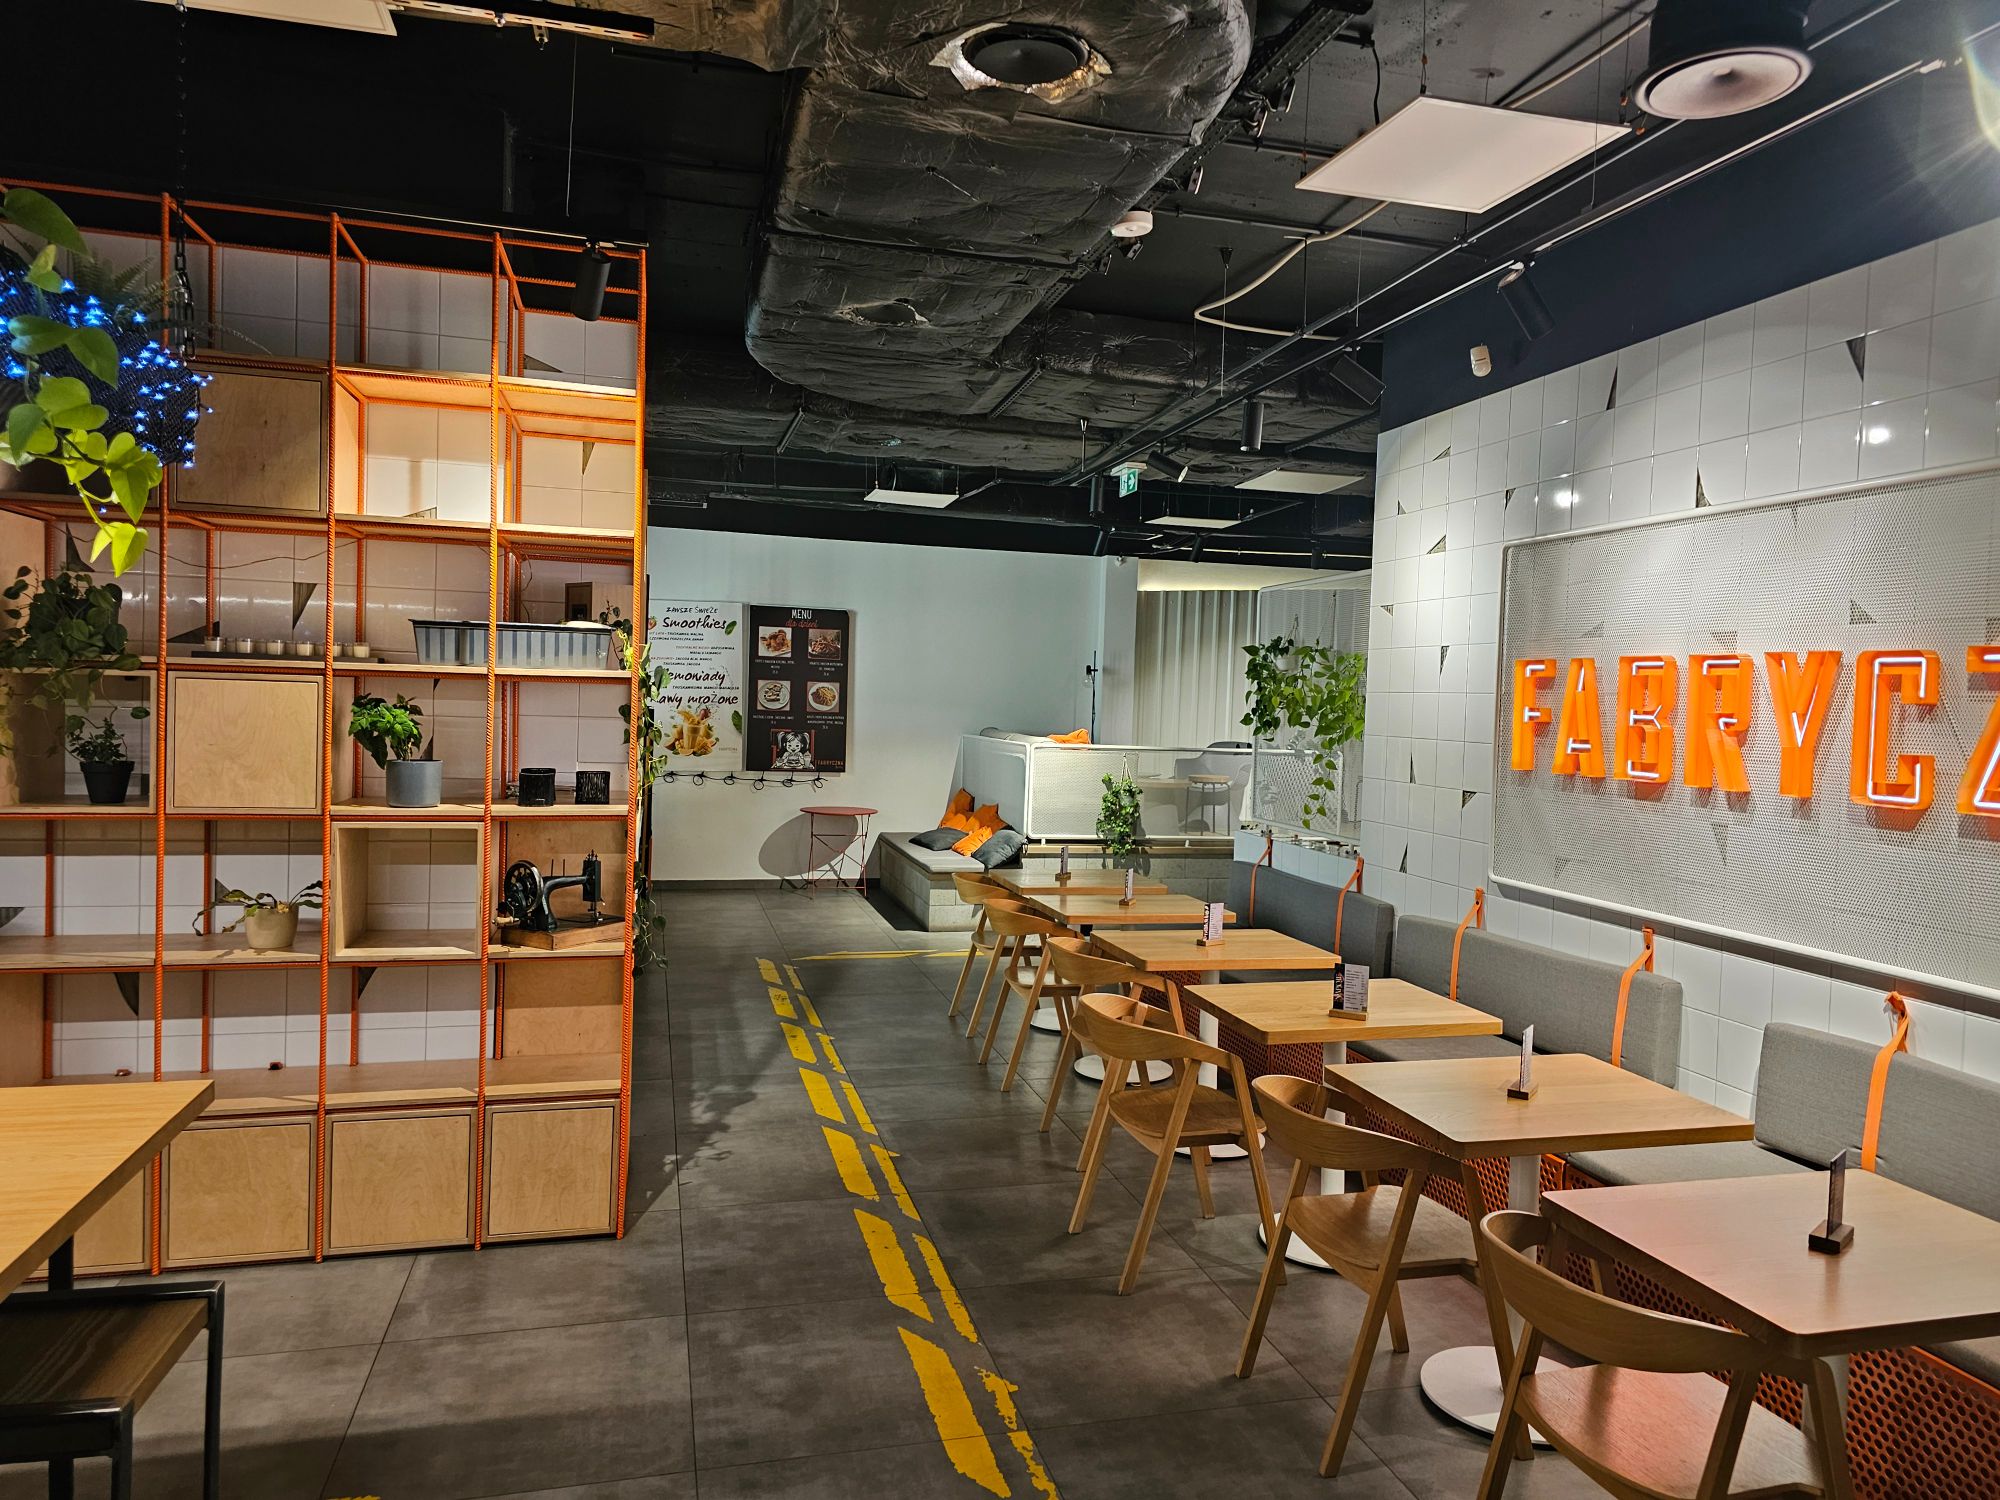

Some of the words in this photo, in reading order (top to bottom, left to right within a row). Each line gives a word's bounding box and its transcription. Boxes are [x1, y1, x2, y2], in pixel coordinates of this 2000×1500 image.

[662, 614, 727, 630] Smoothies
[791, 609, 813, 620] MENU
[664, 670, 726, 687] emoniady
